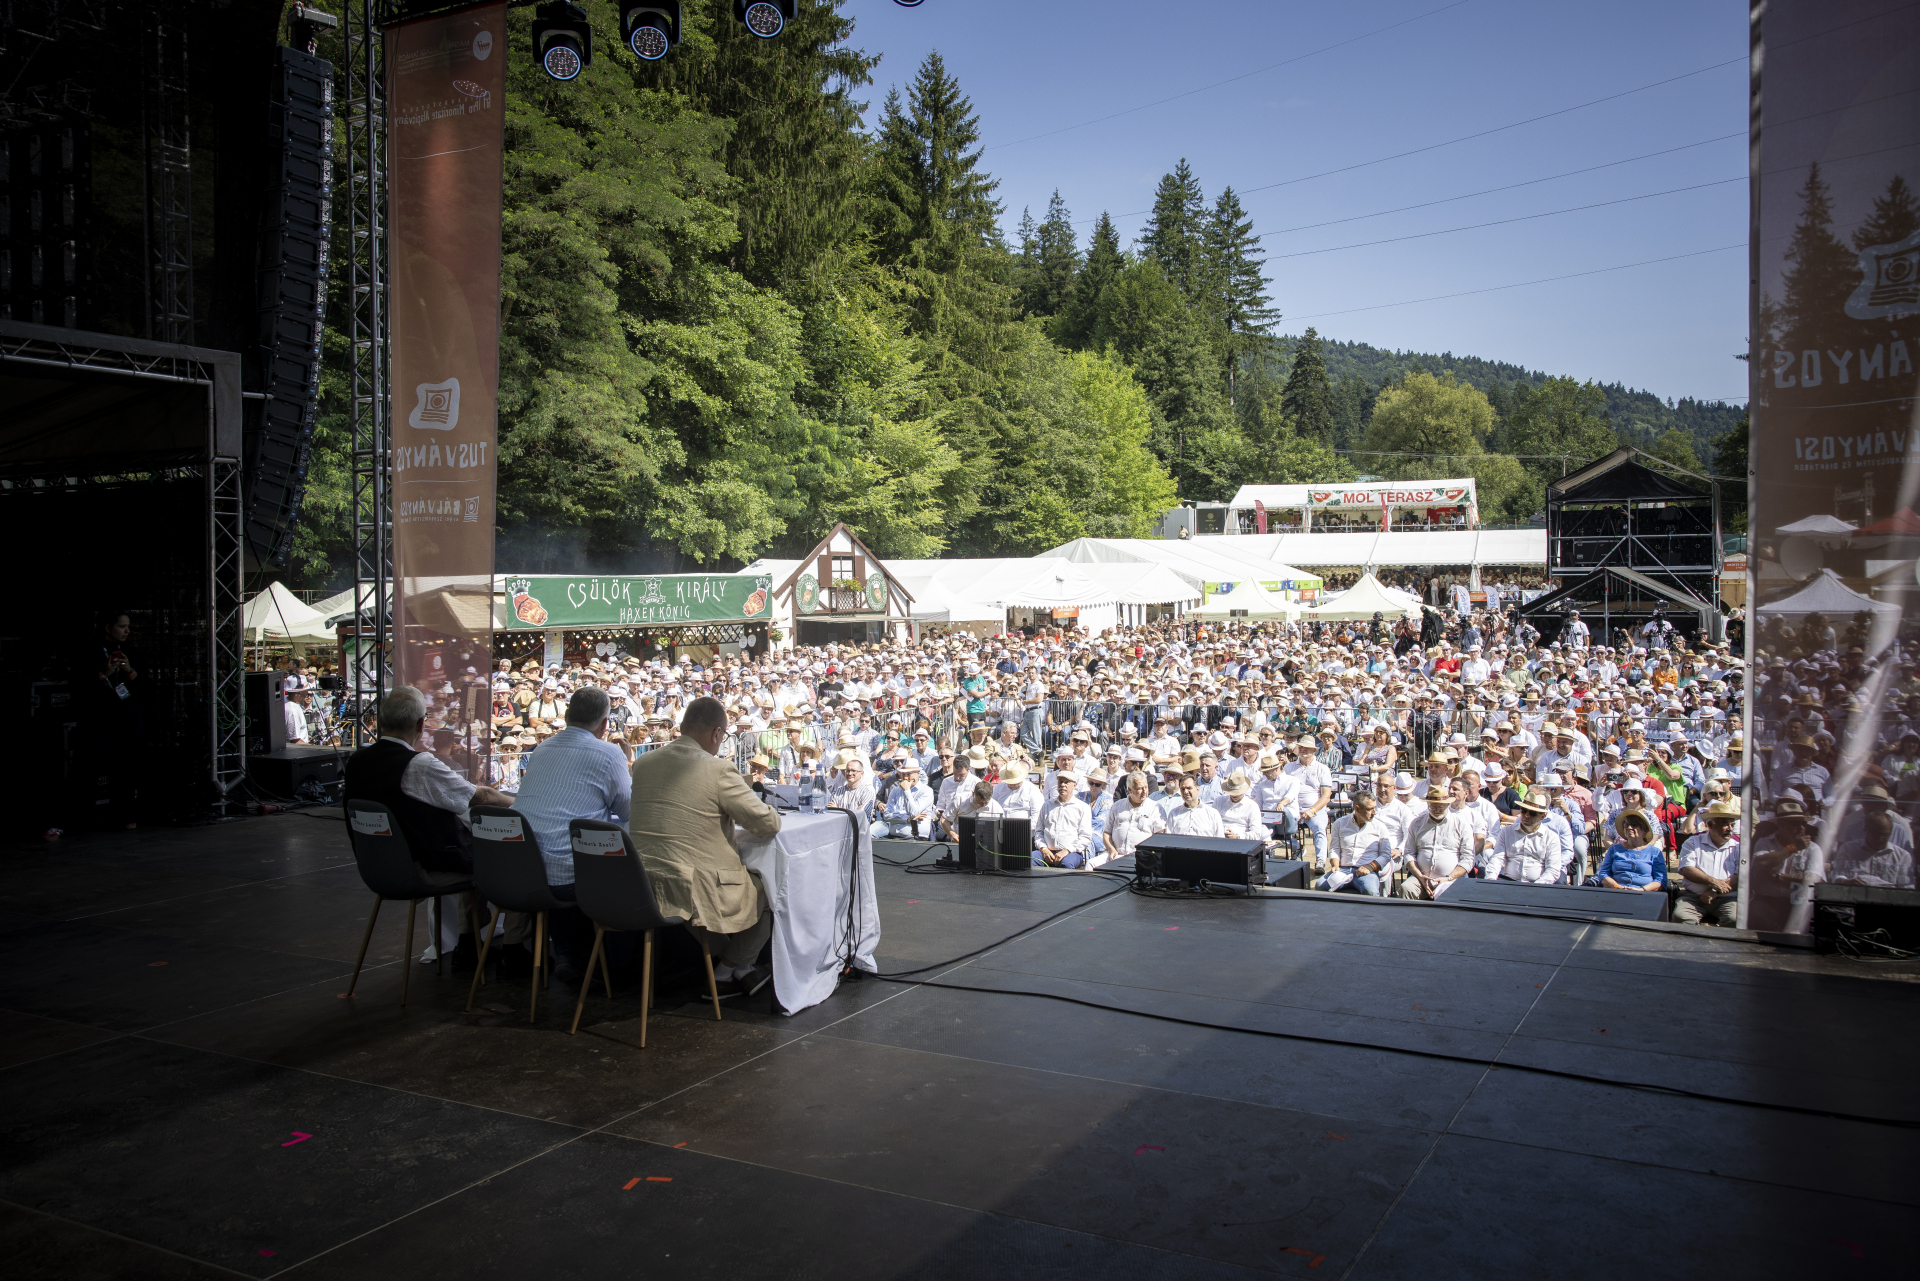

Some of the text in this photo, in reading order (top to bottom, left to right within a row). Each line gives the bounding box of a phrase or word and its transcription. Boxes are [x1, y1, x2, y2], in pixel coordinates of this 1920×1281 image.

[1343, 491, 1433, 504] MOL TERASZ
[567, 577, 728, 608] CSÜLÖK KIRÁLY
[619, 603, 690, 624] HAXEN KÖNIG
